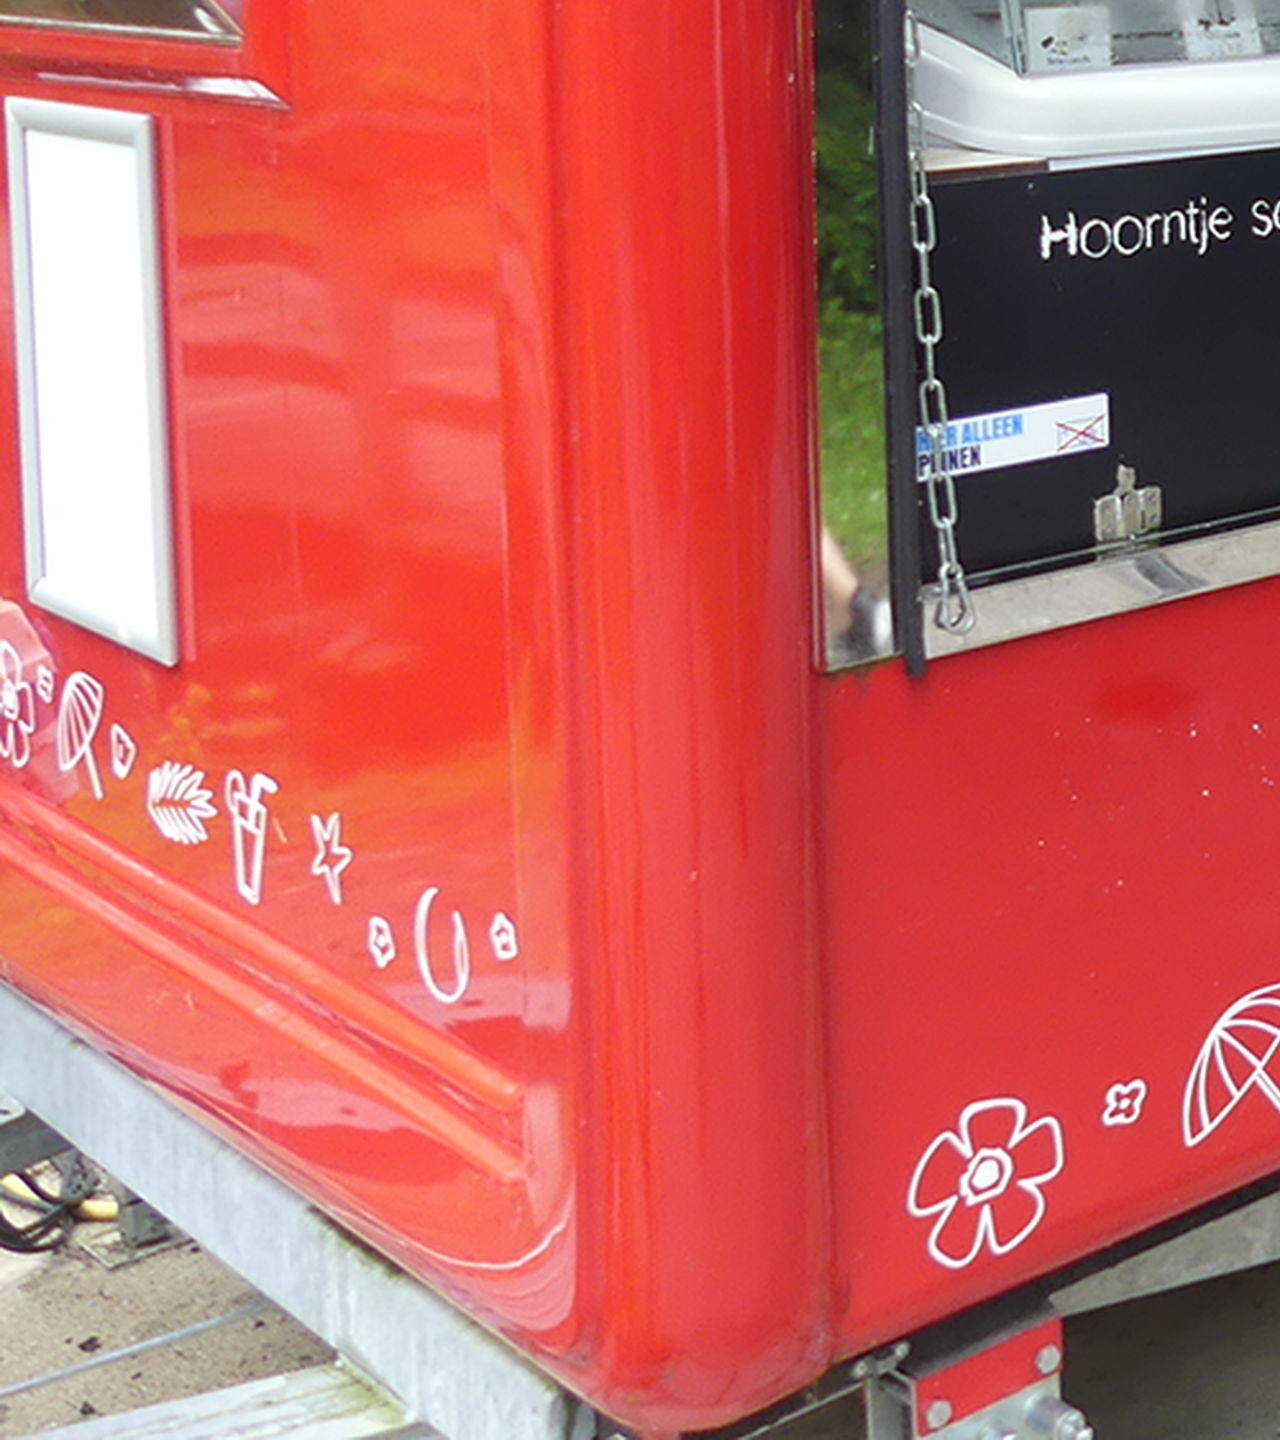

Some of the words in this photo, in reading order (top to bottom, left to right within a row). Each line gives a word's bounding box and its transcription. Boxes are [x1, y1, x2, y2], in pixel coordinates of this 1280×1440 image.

[1040, 196, 1234, 260] Hoorntje
[917, 426, 958, 453] HER
[962, 414, 1023, 444] ALLEEN
